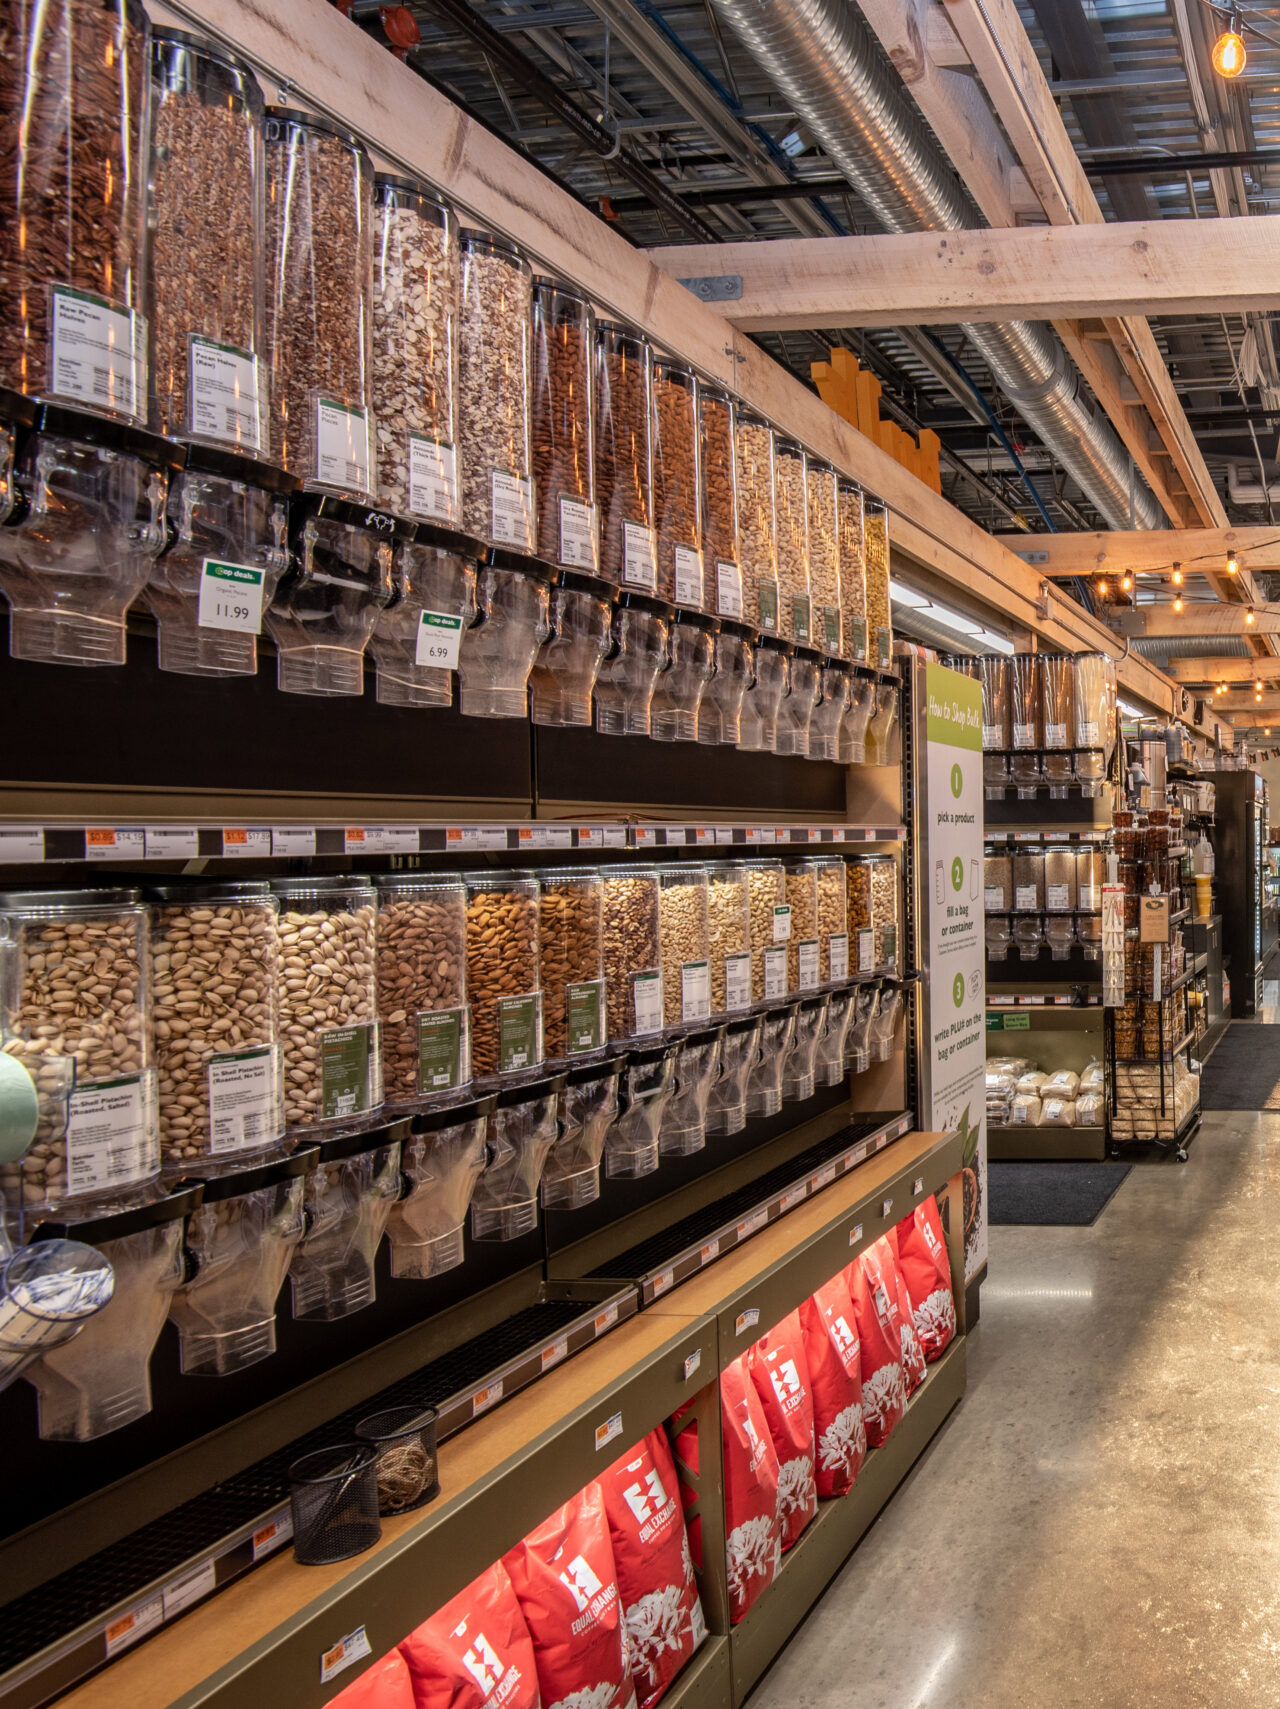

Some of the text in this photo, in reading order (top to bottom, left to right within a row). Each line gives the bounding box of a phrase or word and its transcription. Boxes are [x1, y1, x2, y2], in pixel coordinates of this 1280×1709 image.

[59, 303, 101, 321] Raw Pecan
[59, 312, 86, 324] Halves
[195, 352, 237, 368] Pecan Halves
[195, 359, 216, 369] (Raw)
[321, 410, 338, 419] Pecan
[321, 417, 339, 426] Pieces
[217, 603, 249, 620] 11.99
[429, 646, 448, 658] 6.99
[929, 695, 980, 731] How to Shop Bulk
[955, 772, 959, 791] 1
[938, 811, 975, 825] pick a product
[116, 832, 144, 841] $14.19
[226, 832, 270, 840] $1.12 $17.89
[955, 865, 960, 883] 2
[946, 904, 969, 918] fill a bag
[941, 921, 974, 937] or container
[956, 981, 961, 1000] 3
[934, 1013, 982, 1043] write PLU# on the
[938, 1030, 980, 1061] bag or container
[213, 1076, 242, 1085] (Roasted,
[221, 1069, 237, 1077] Shell
[69, 1099, 99, 1109] In-Shell
[69, 1101, 131, 1118] (Roasted, Salted)
[638, 1496, 677, 1544] EQUAL EXCHANGE
[571, 1609, 595, 1637] EQUAL
